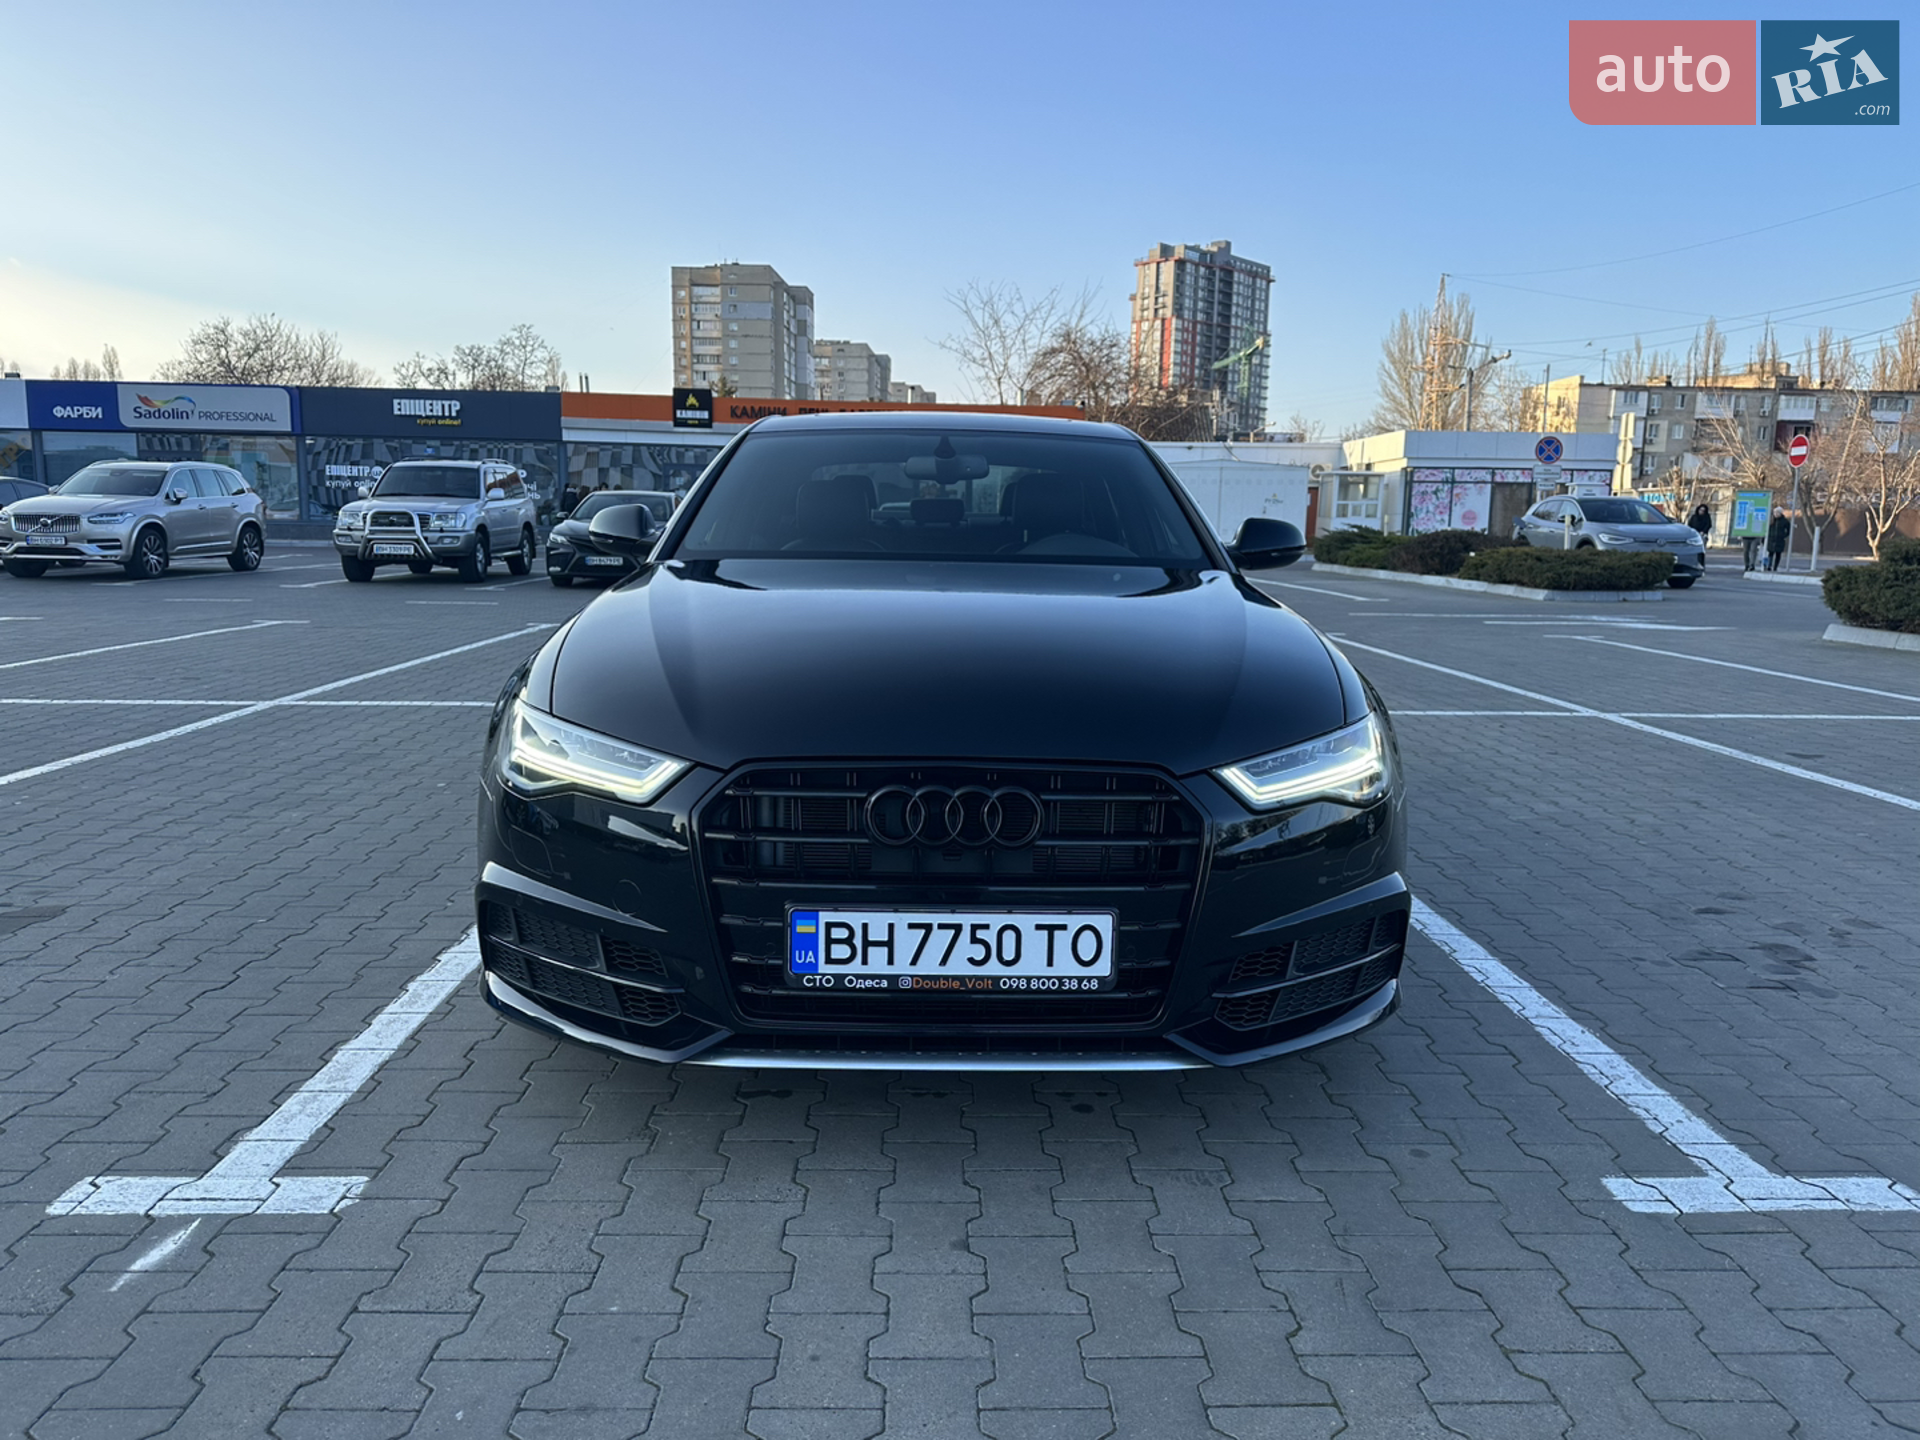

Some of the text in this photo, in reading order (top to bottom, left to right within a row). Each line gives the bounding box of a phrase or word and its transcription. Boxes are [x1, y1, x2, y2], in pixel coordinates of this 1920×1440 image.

[52, 404, 103, 420] ФАРБИ
[133, 406, 277, 423] Sadolin PROFESSIONAL
[392, 398, 461, 417] ЕПІЦЕНТР
[353, 479, 376, 488] onlin
[823, 921, 1104, 968] BH 7750 TO
[795, 949, 815, 964] UA
[803, 975, 1099, 990] СТО Одеса Double_Volt 098 800 38 68
